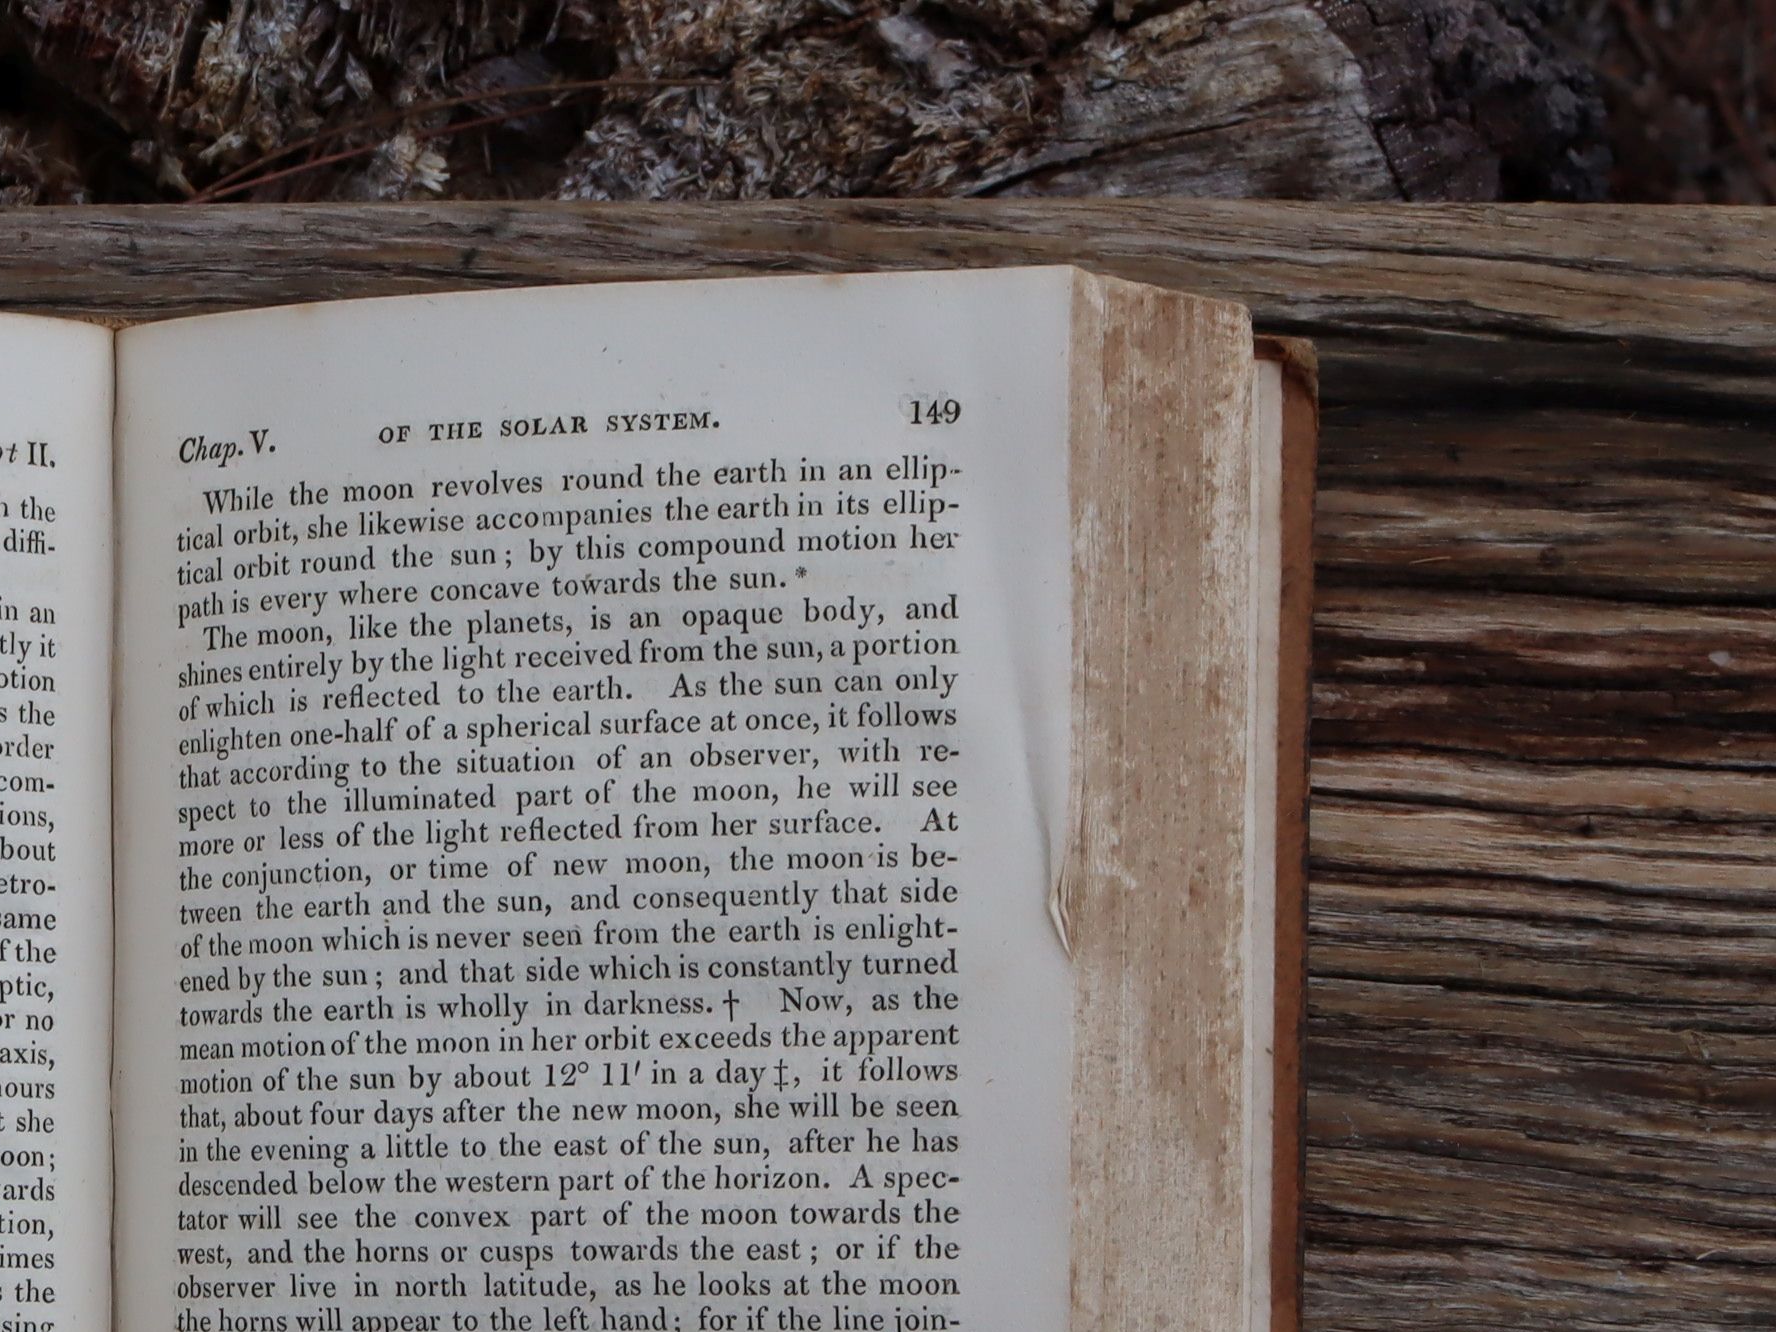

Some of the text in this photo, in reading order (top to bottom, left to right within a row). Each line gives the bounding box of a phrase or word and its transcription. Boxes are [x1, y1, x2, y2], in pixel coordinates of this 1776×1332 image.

[377, 410, 721, 445] OF THE SOLAR SYSTEM.
[909, 398, 962, 426] 149
[26, 440, 56, 469] II.
[178, 427, 276, 469] Chap. V.
[201, 453, 964, 516] While the moon revolves round the earth in an ellip-
[19, 495, 57, 524] the
[178, 736, 960, 791] that according to the situation of an observer, with re-
[14, 938, 58, 965] the
[178, 1163, 960, 1201] descended below the western part of the horizon. A spec-
